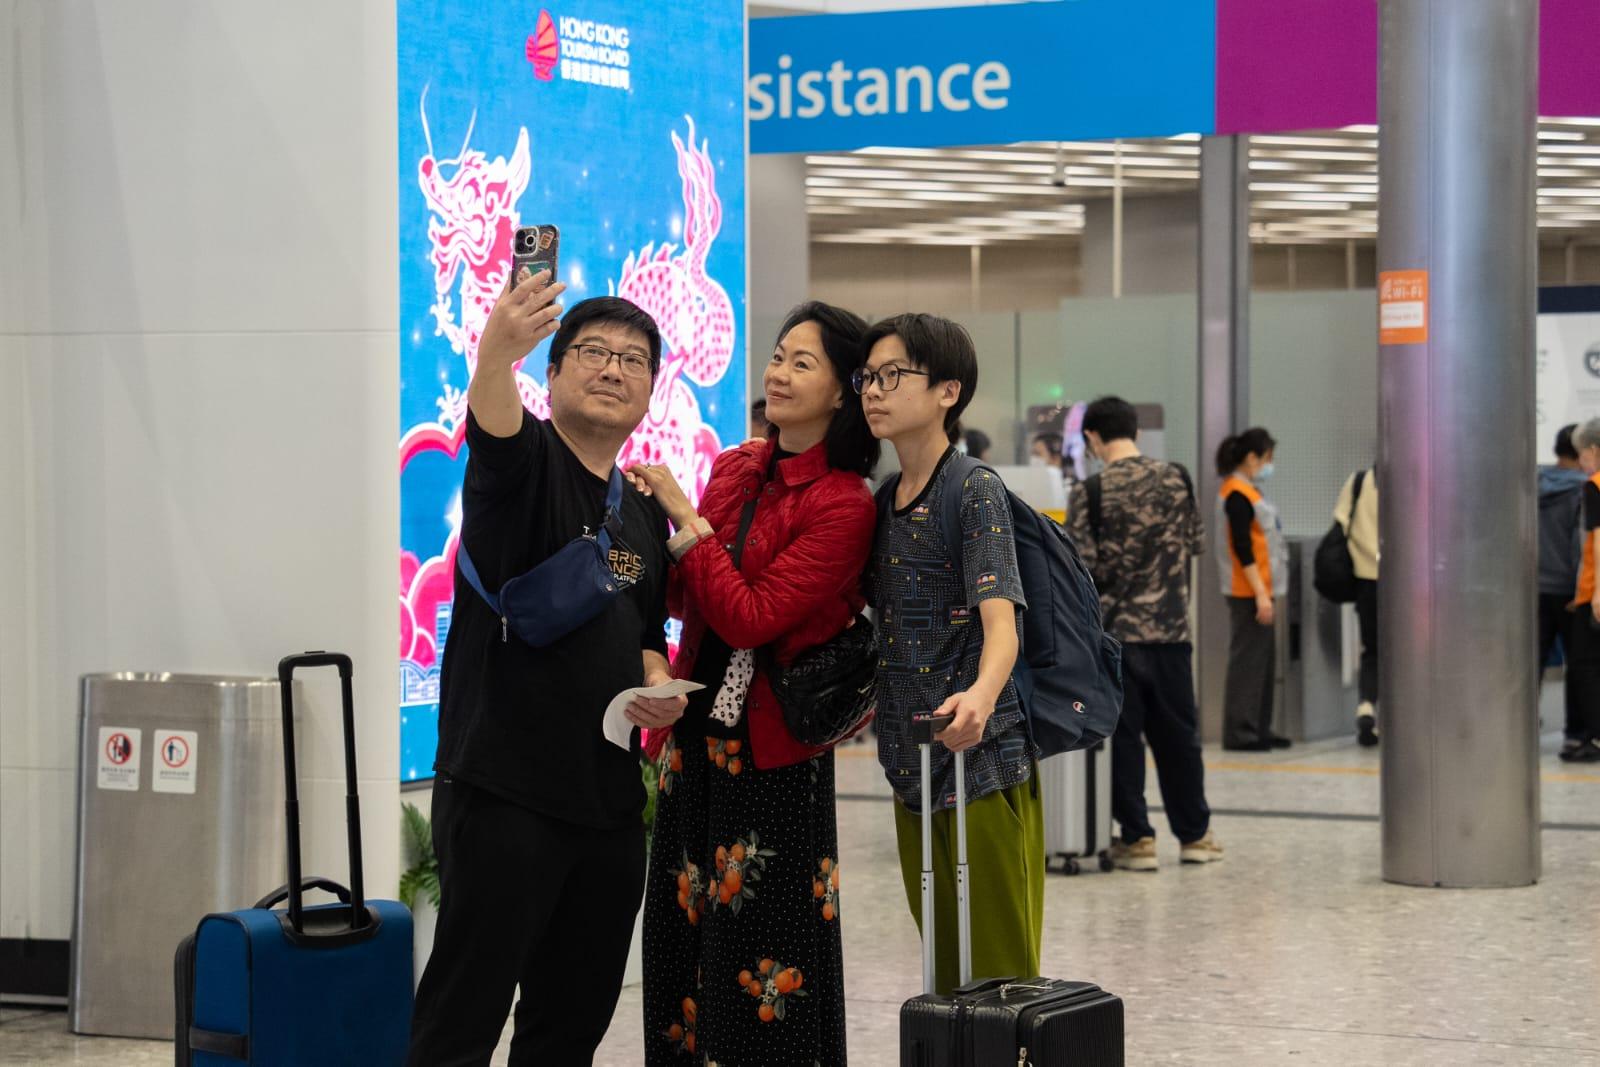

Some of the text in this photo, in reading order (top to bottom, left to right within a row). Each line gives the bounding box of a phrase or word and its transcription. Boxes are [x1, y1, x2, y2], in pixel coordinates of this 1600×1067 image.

[560, 16, 629, 48] HONG KONG
[748, 54, 1011, 121] sistance
